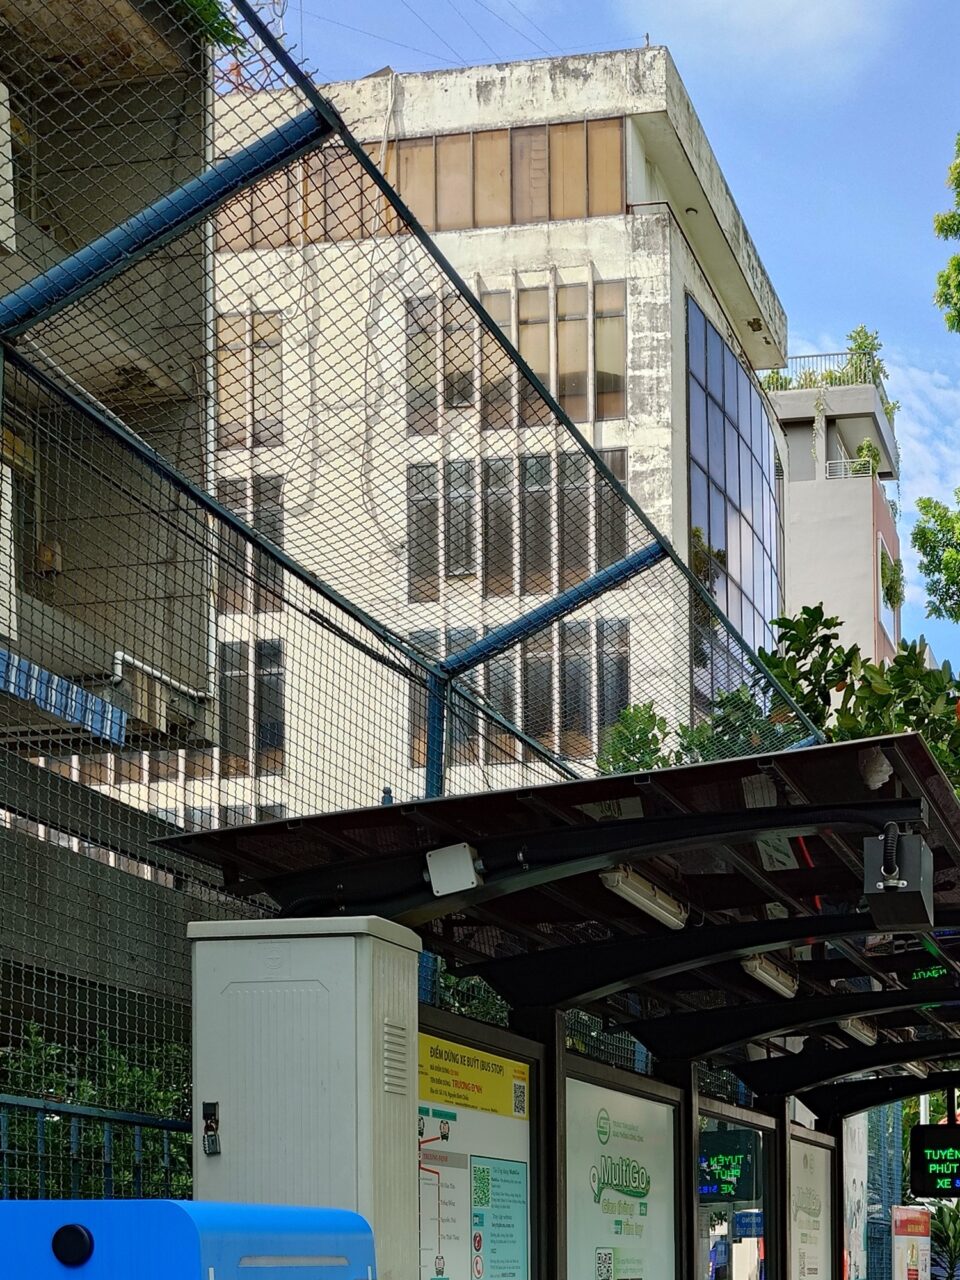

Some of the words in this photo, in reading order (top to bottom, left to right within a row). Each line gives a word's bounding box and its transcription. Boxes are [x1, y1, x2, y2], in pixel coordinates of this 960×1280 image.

[600, 1155, 648, 1190] MultiGo
[929, 1162, 959, 1174] PHÚT
[936, 1179, 952, 1189] XE
